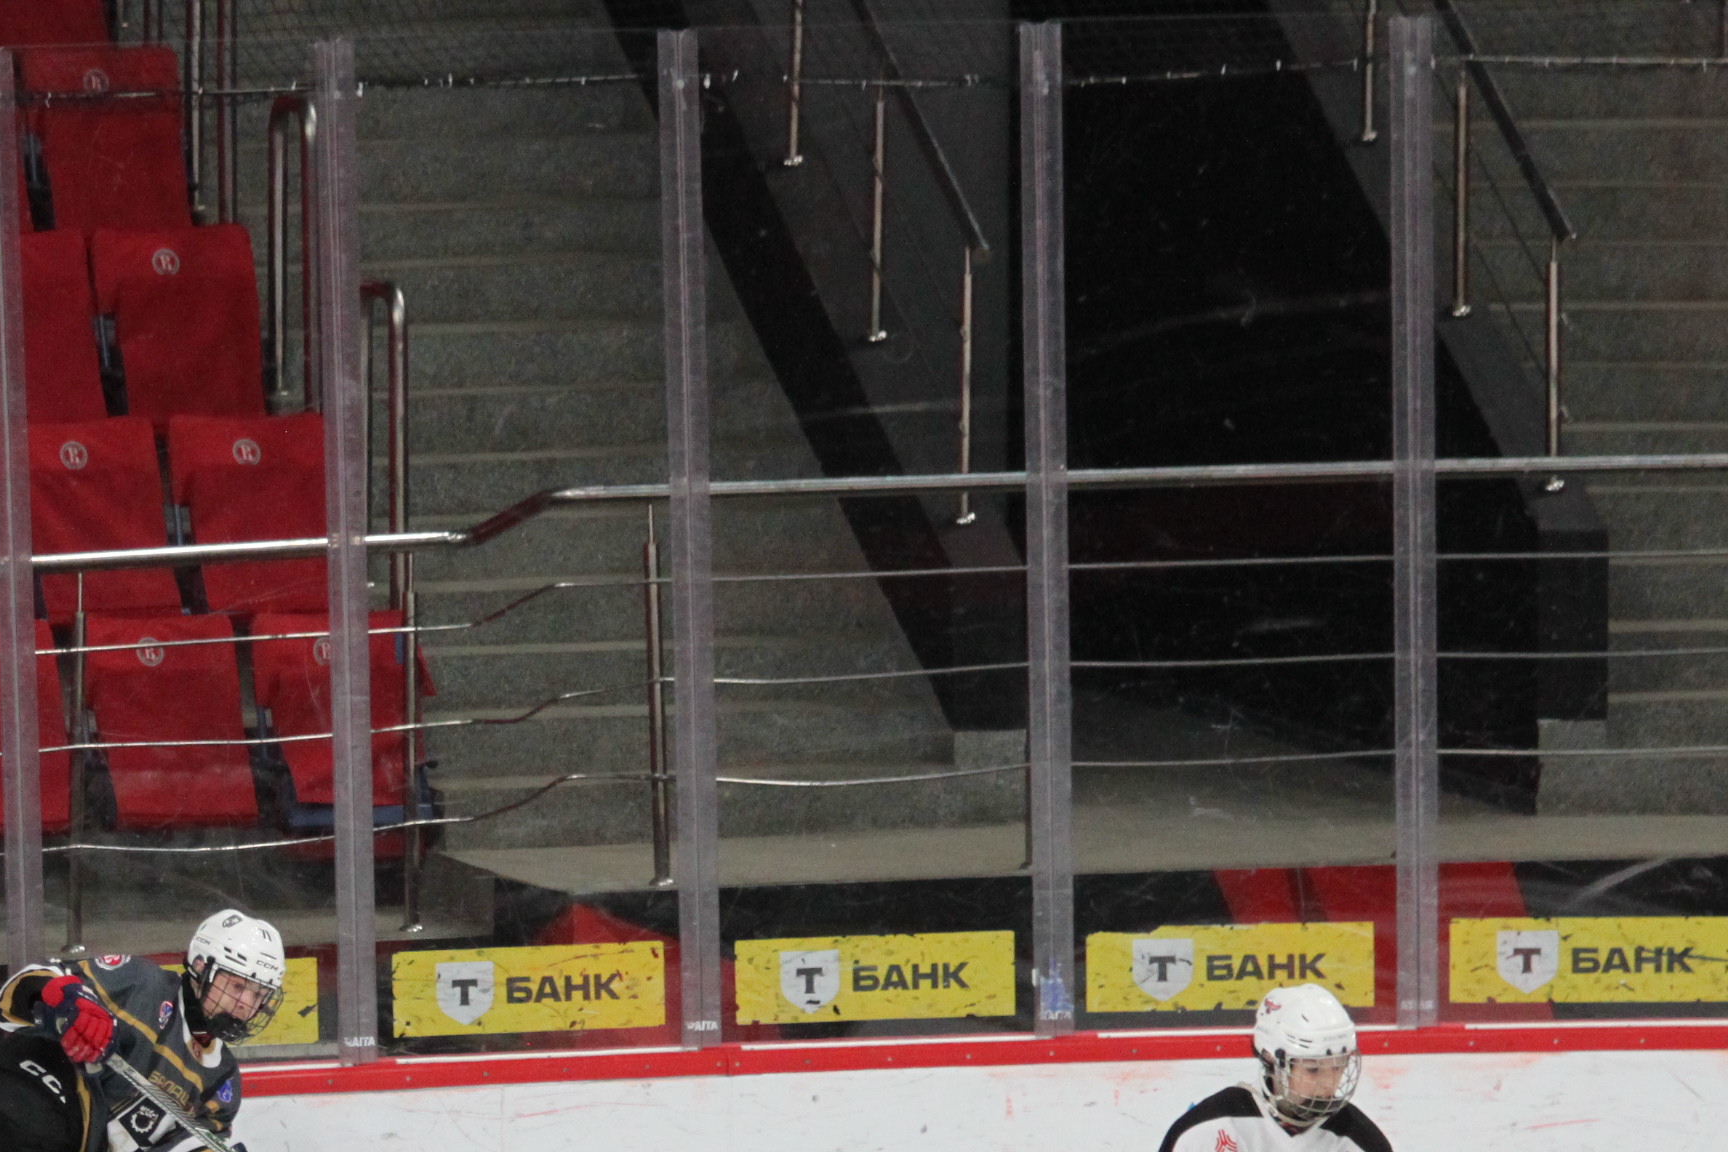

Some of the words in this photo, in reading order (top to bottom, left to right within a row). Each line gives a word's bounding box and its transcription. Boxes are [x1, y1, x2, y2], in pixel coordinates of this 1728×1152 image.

[1148, 955, 1176, 982] Т
[1205, 952, 1327, 982] БАНК
[1512, 947, 1541, 975] Т
[1571, 945, 1695, 974] БАНК
[451, 978, 479, 1007] Т
[505, 972, 620, 1005] БАНК
[795, 967, 823, 995] Т
[851, 961, 970, 993] БАНК
[19, 1059, 67, 1104] CC
